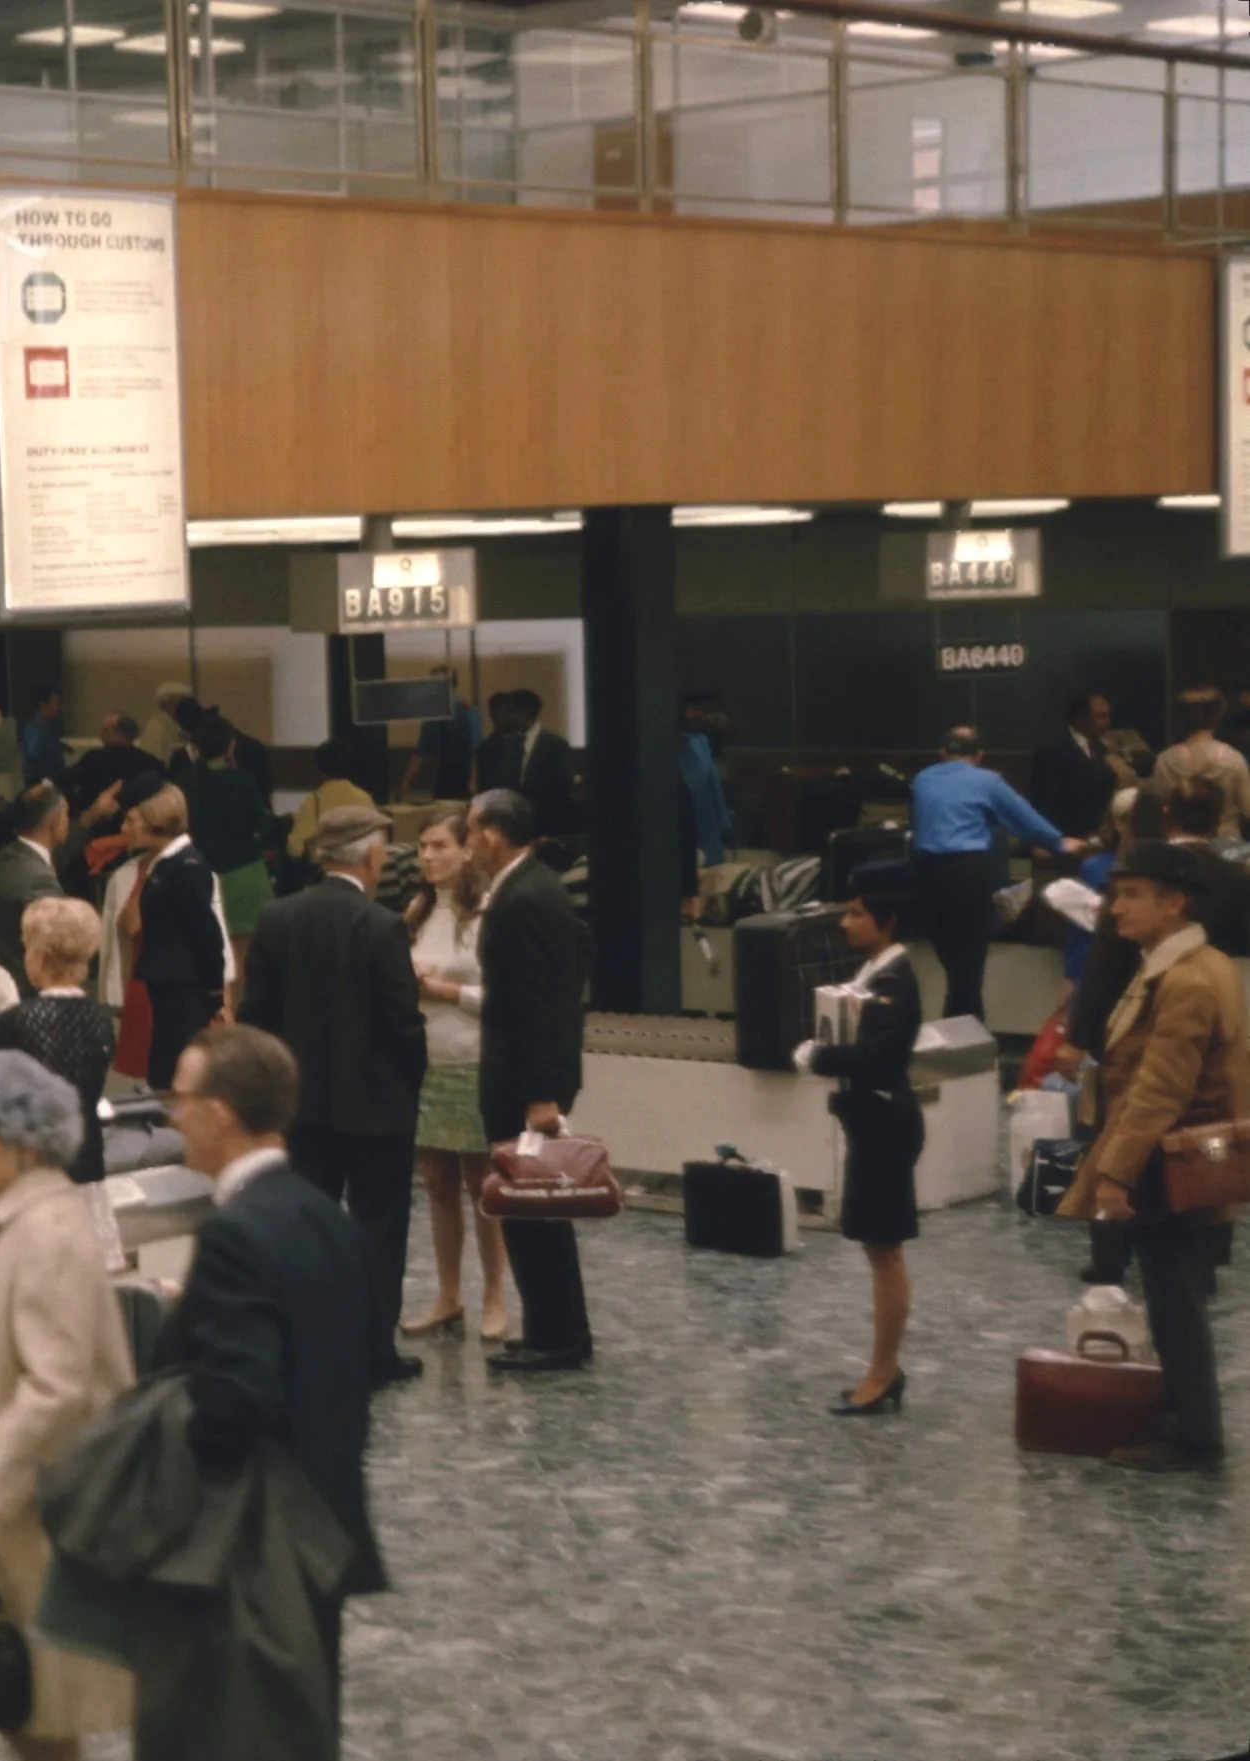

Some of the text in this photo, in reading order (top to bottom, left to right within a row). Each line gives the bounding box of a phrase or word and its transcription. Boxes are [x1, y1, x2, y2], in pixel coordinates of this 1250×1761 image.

[15, 209, 112, 228] HOW TO GO
[18, 232, 166, 254] THROUGH CUSTOMS
[929, 560, 1015, 586] BA440
[344, 586, 445, 617] BA915
[940, 643, 1025, 671] BA6440
